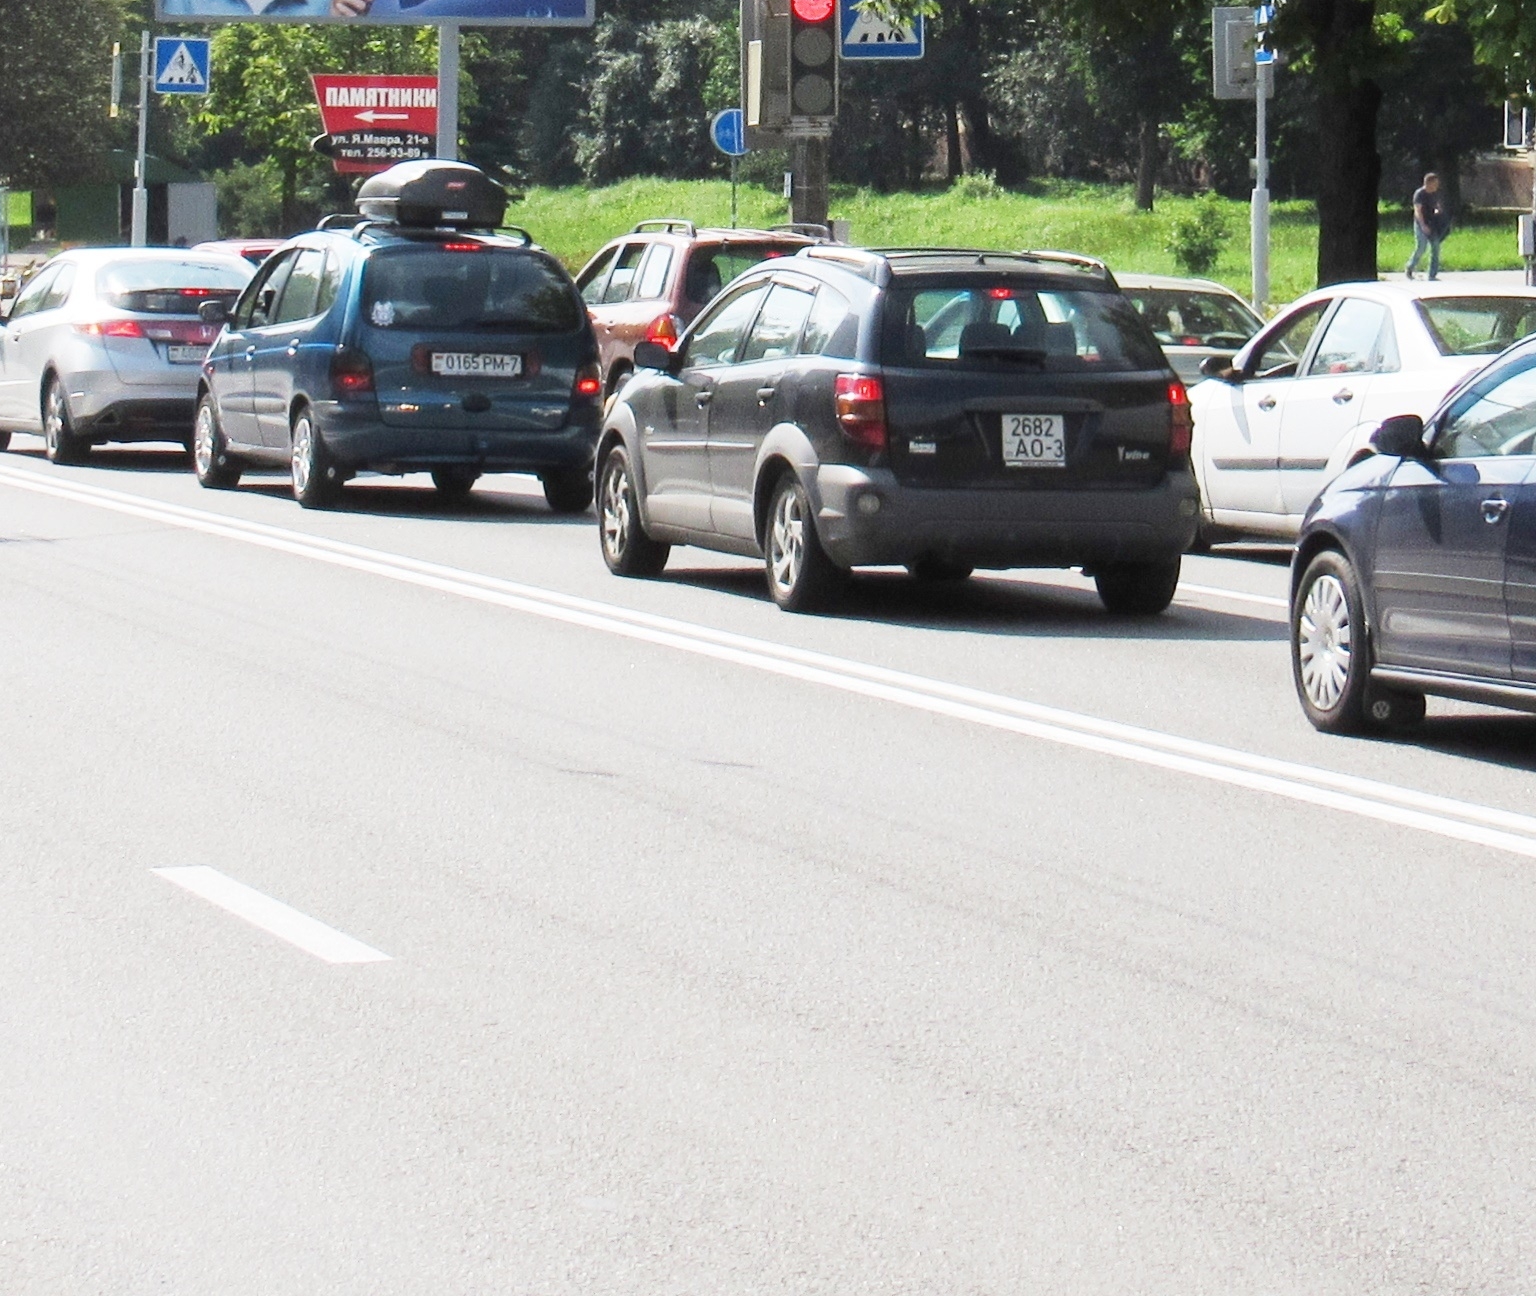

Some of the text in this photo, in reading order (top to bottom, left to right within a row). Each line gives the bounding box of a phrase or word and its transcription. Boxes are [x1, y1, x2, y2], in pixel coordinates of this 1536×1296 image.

[325, 87, 437, 108] ПАМЯТНИКИ
[331, 135, 349, 146] ул.
[340, 147, 364, 158] тел.
[445, 355, 480, 370] 0165
[1011, 417, 1054, 437] 2682
[1015, 438, 1063, 458] AO-3
